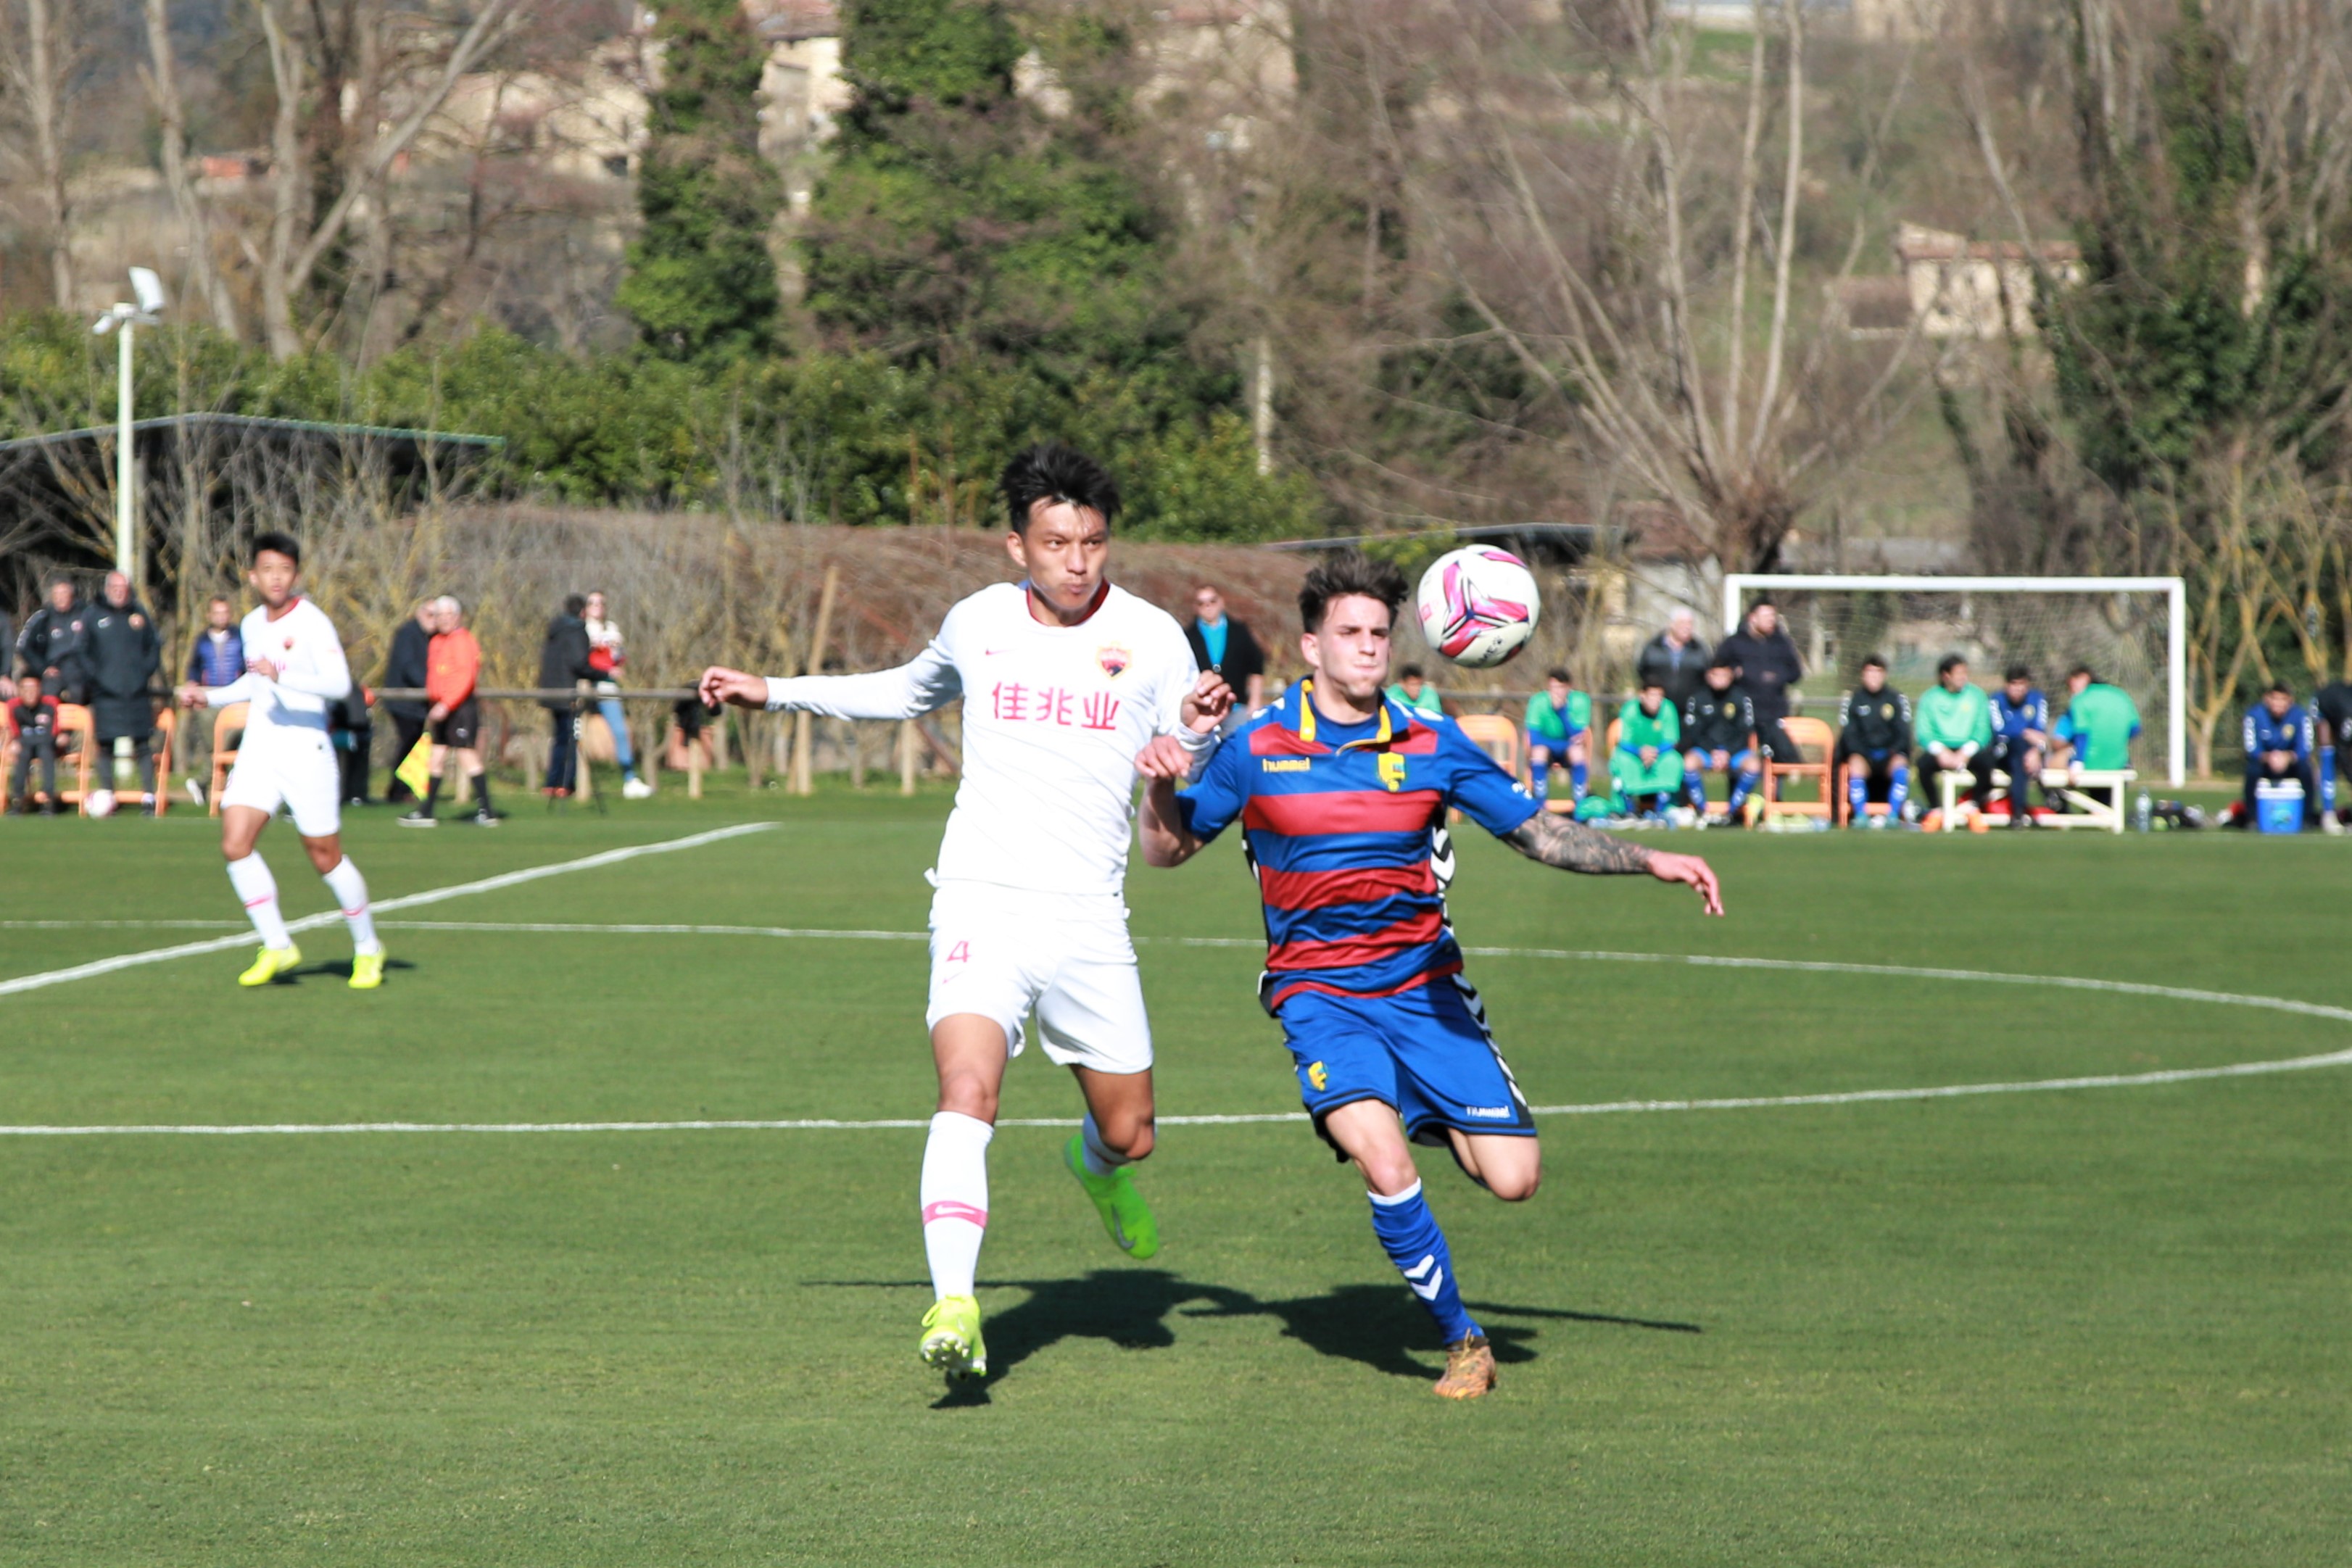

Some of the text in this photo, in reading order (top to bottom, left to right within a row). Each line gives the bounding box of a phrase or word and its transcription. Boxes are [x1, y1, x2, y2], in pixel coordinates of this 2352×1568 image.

[992, 681, 1119, 730] 佳兆业
[946, 940, 972, 963] 4
